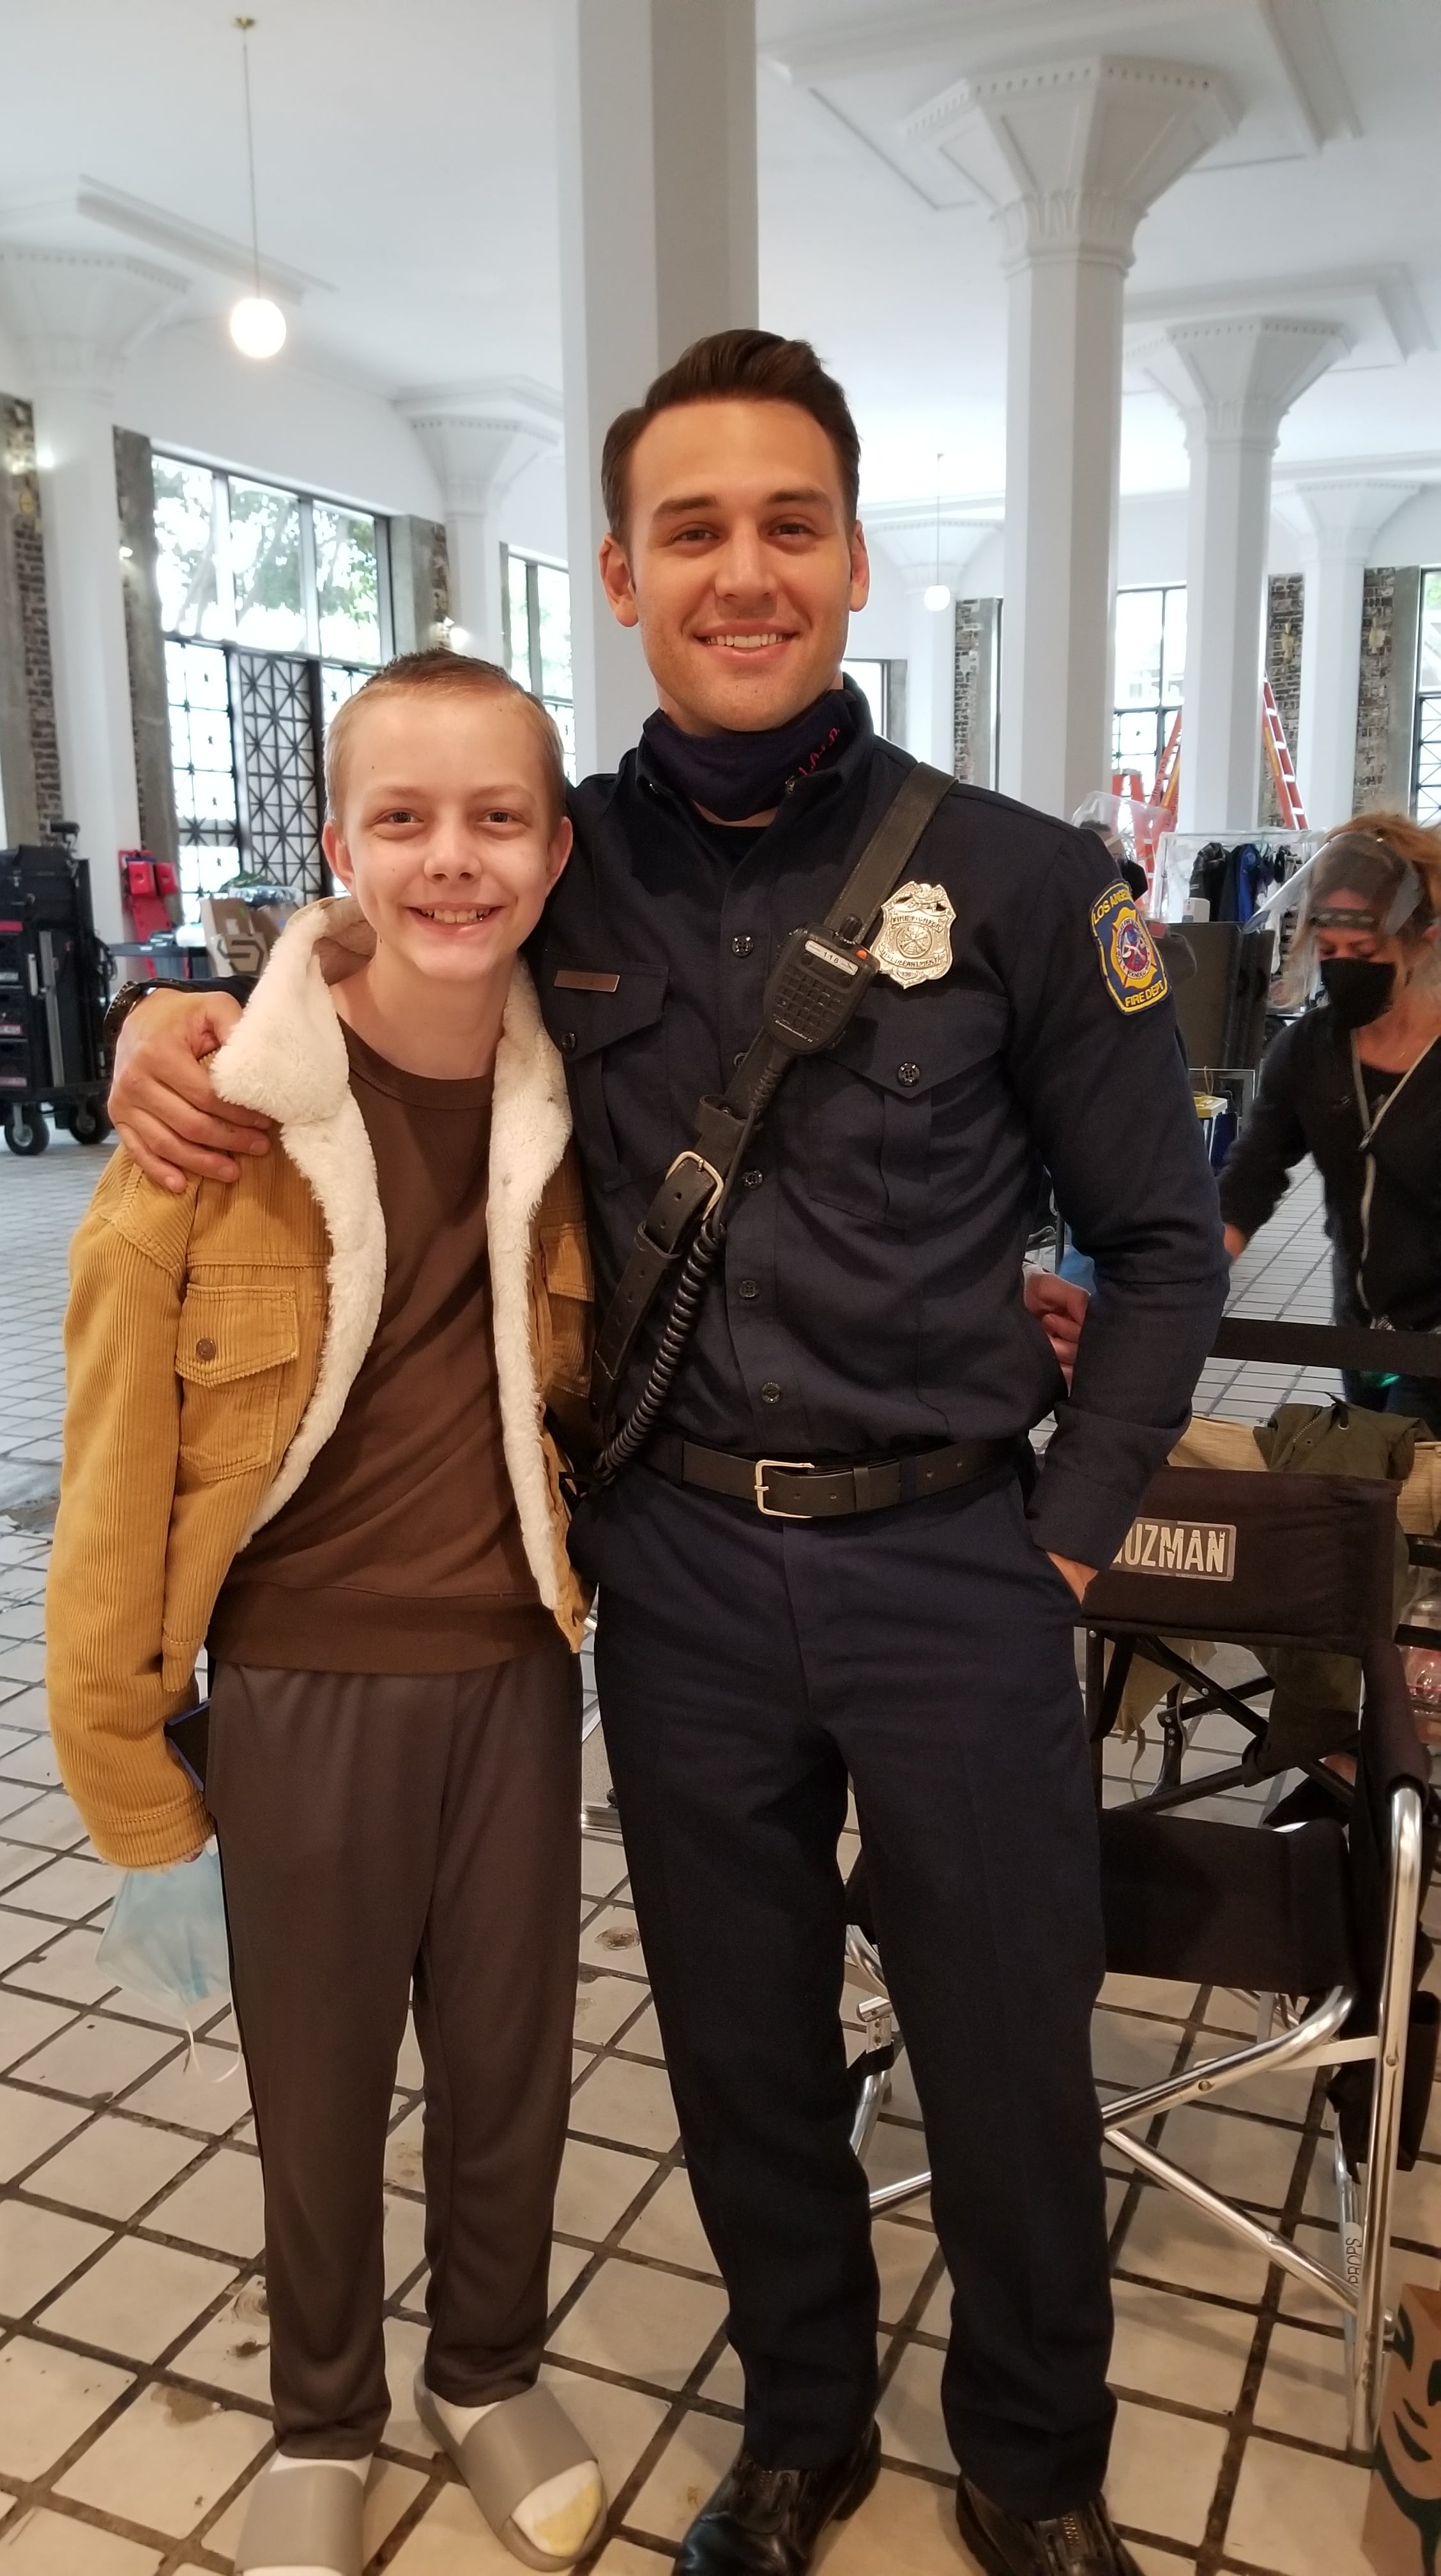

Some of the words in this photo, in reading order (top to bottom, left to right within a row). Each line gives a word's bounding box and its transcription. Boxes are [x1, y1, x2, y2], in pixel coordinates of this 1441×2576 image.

[1093, 900, 1111, 924] LOS
[823, 952, 839, 963] 118
[895, 957, 938, 967] DEPARTMENT
[1125, 992, 1145, 1007] FIRE
[1145, 980, 1163, 1000] DEPT
